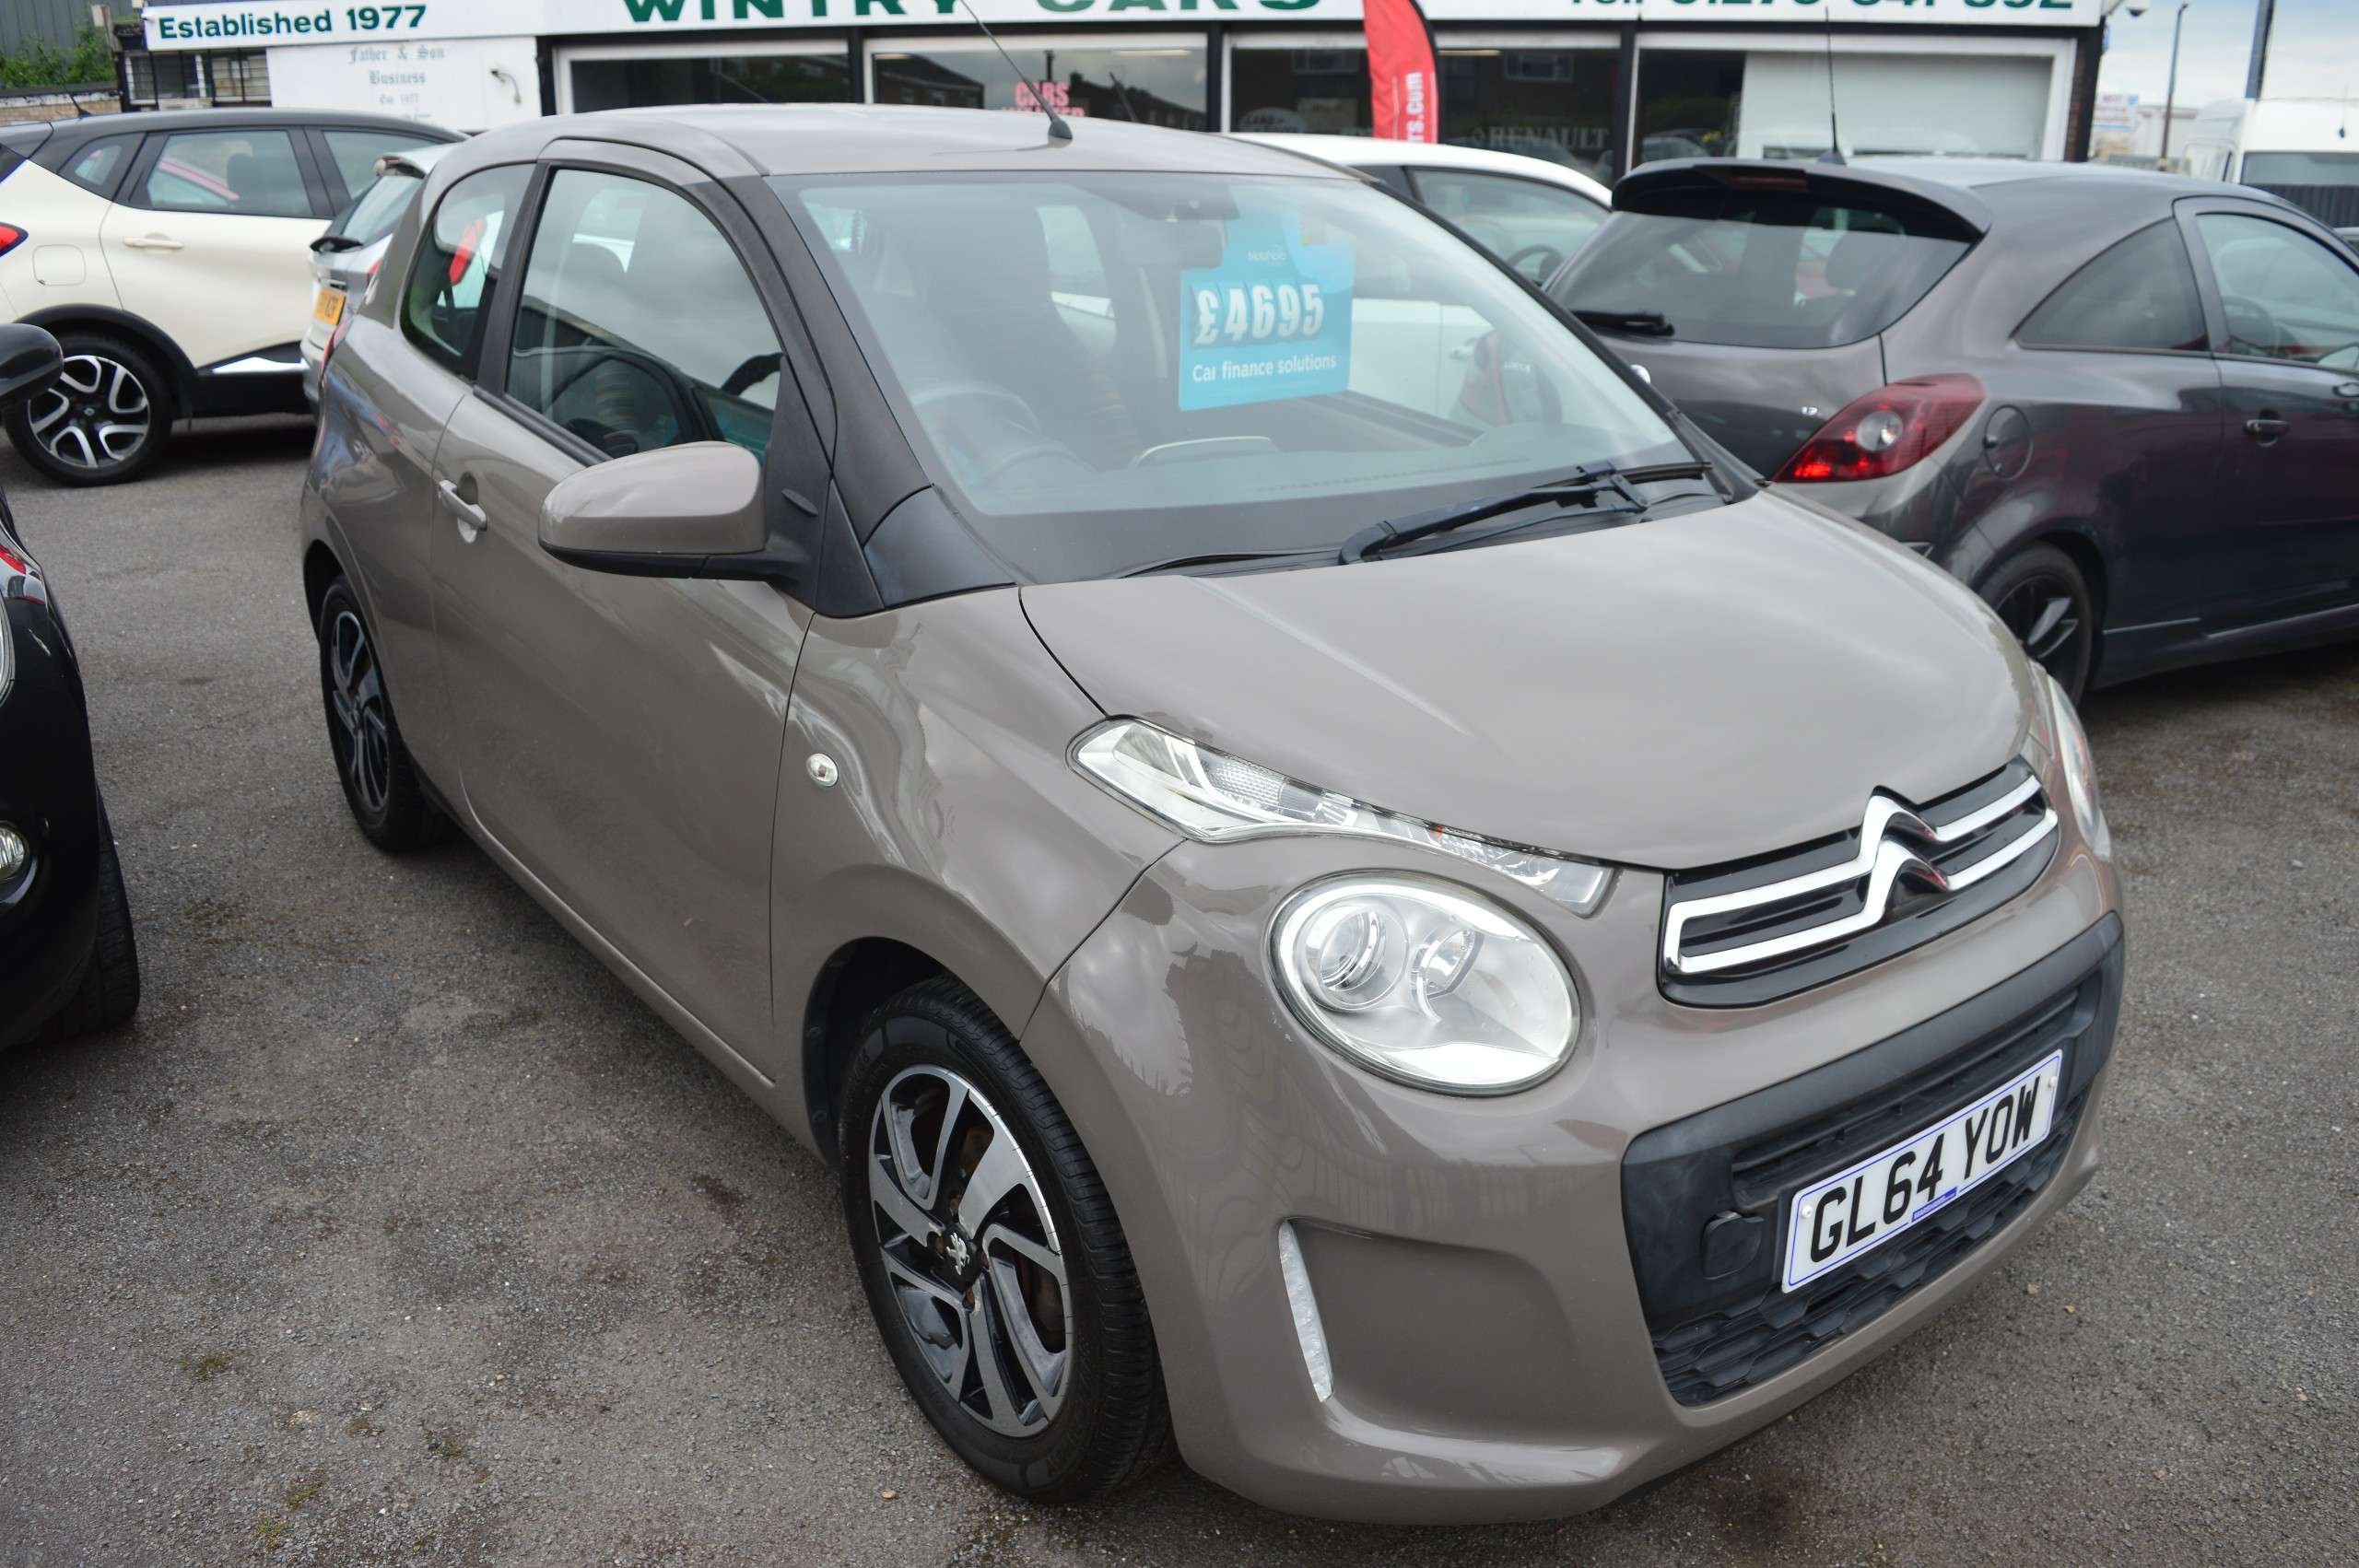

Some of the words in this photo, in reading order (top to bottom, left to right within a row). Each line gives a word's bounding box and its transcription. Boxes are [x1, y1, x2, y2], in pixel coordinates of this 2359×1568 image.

[158, 9, 333, 39] Established
[346, 5, 427, 30] 1977
[1488, 126, 1610, 149] RENAULT
[1193, 284, 1325, 345] £4695
[1222, 360, 1273, 380] finance
[1278, 354, 1337, 375] solutions
[1810, 1132, 1946, 1263] GL64
[1964, 1076, 2041, 1180] YOW
